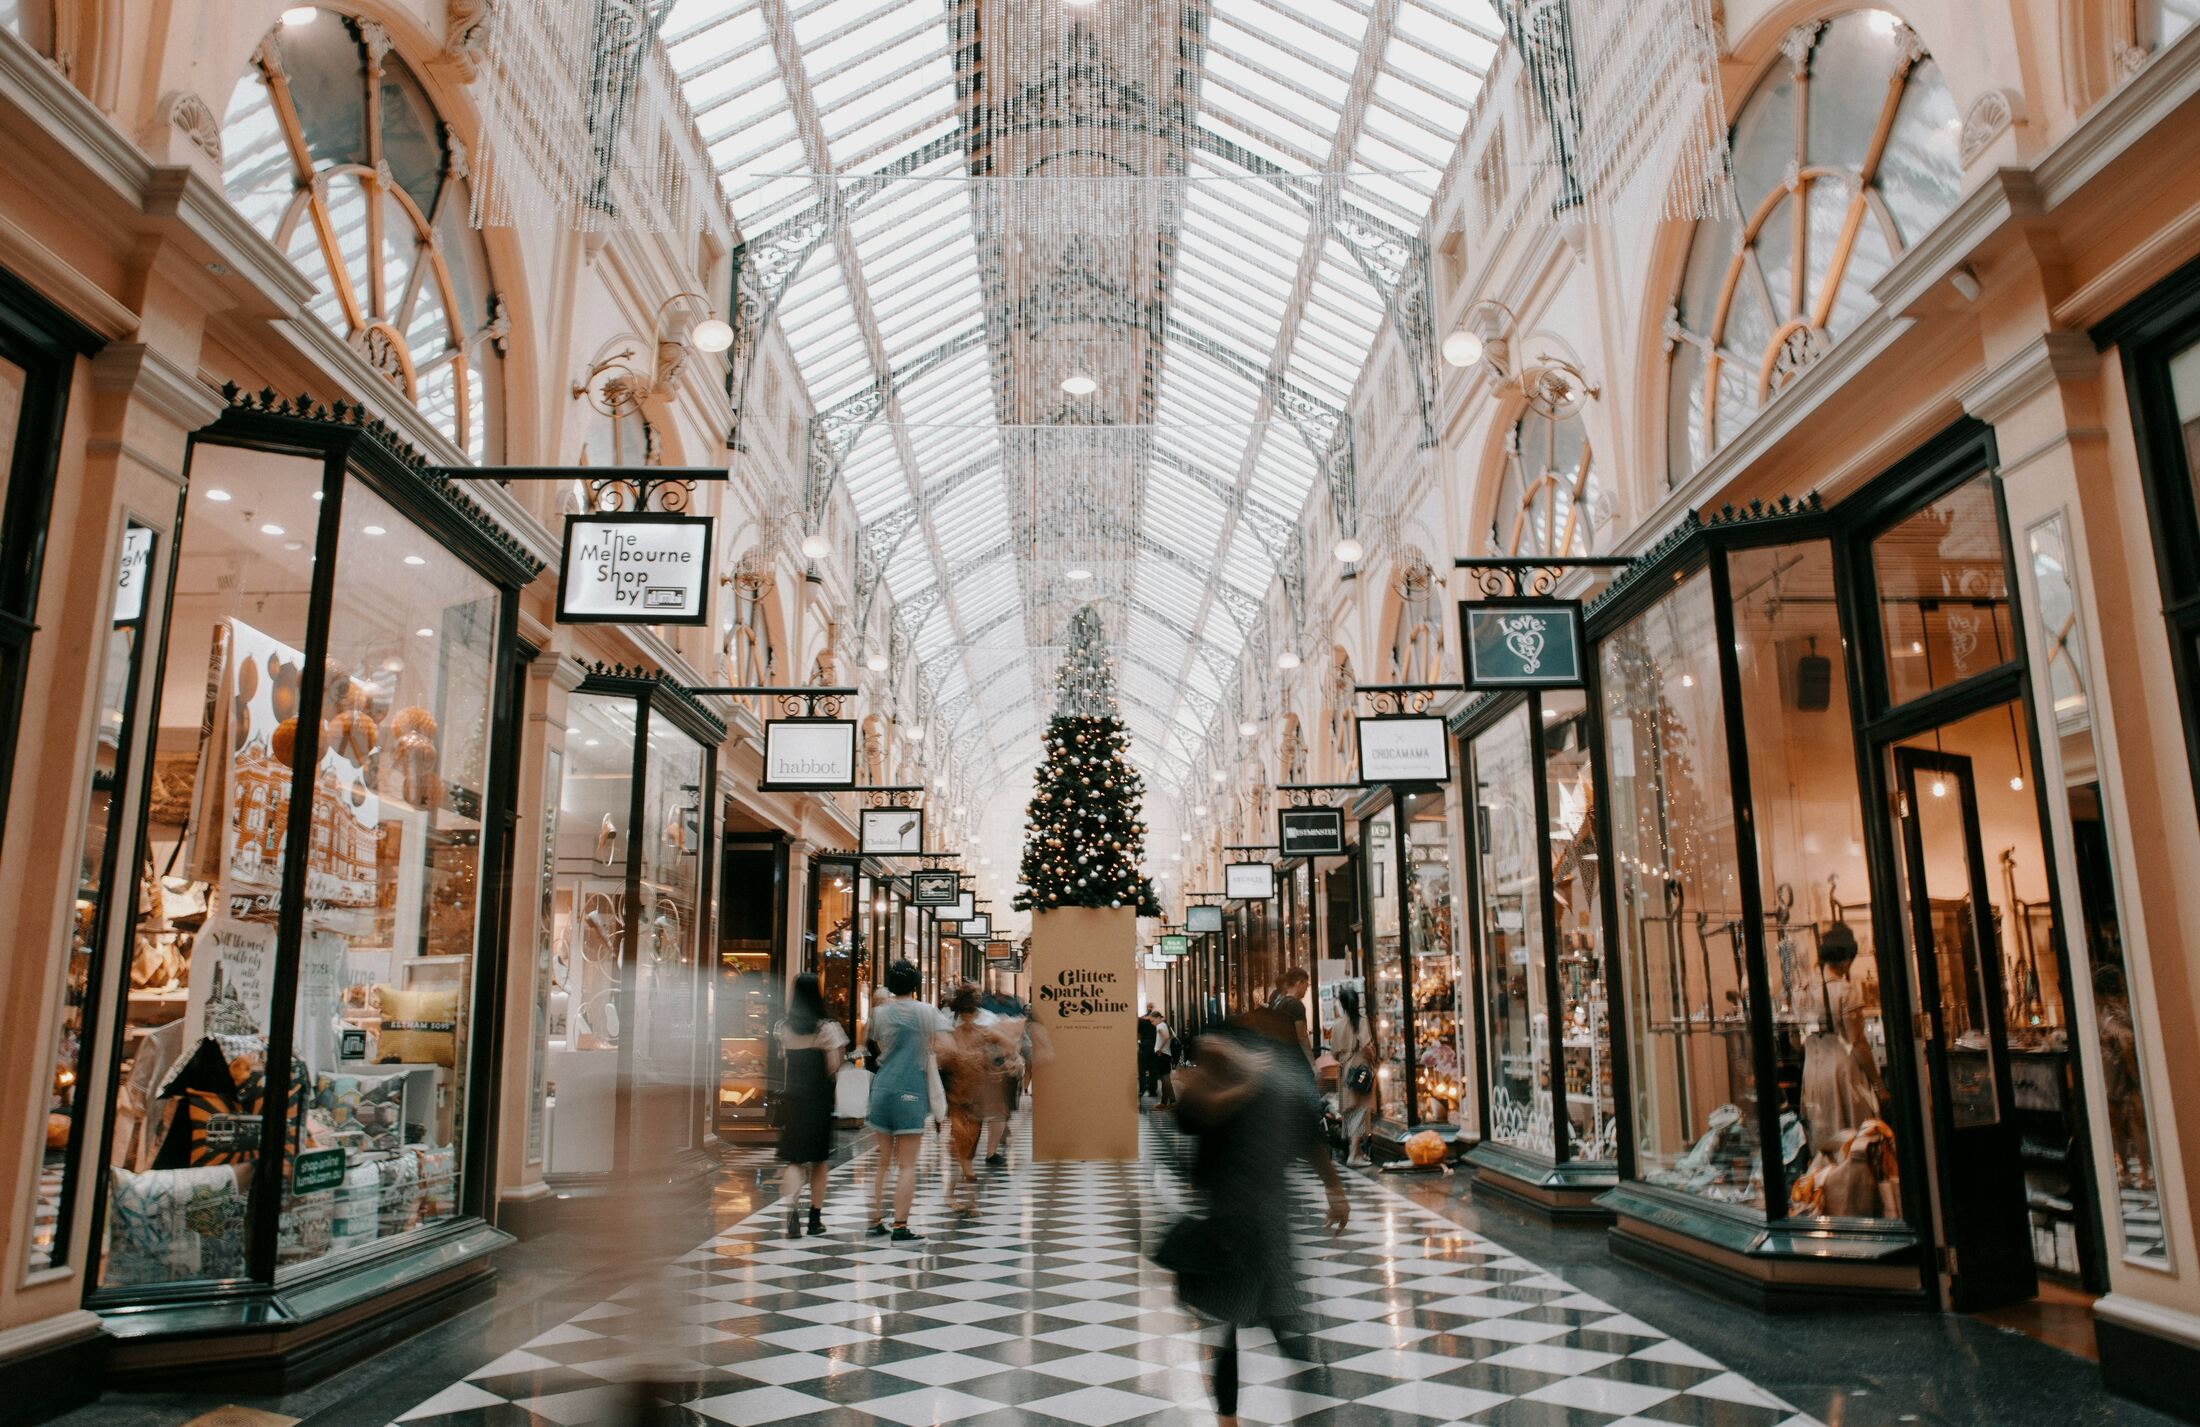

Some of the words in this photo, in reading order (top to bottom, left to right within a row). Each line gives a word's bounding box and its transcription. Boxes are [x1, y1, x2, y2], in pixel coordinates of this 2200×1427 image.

[603, 529, 637, 546] The
[580, 544, 691, 562] Melbourne
[597, 564, 649, 587] Shop
[615, 588, 639, 605] by
[1371, 748, 1430, 760] CHOCAMAMA
[778, 758, 841, 774] habbot.
[1040, 984, 1104, 1001] Sparkle
[1058, 1000, 1079, 1018] &
[1080, 999, 1129, 1016] Shine
